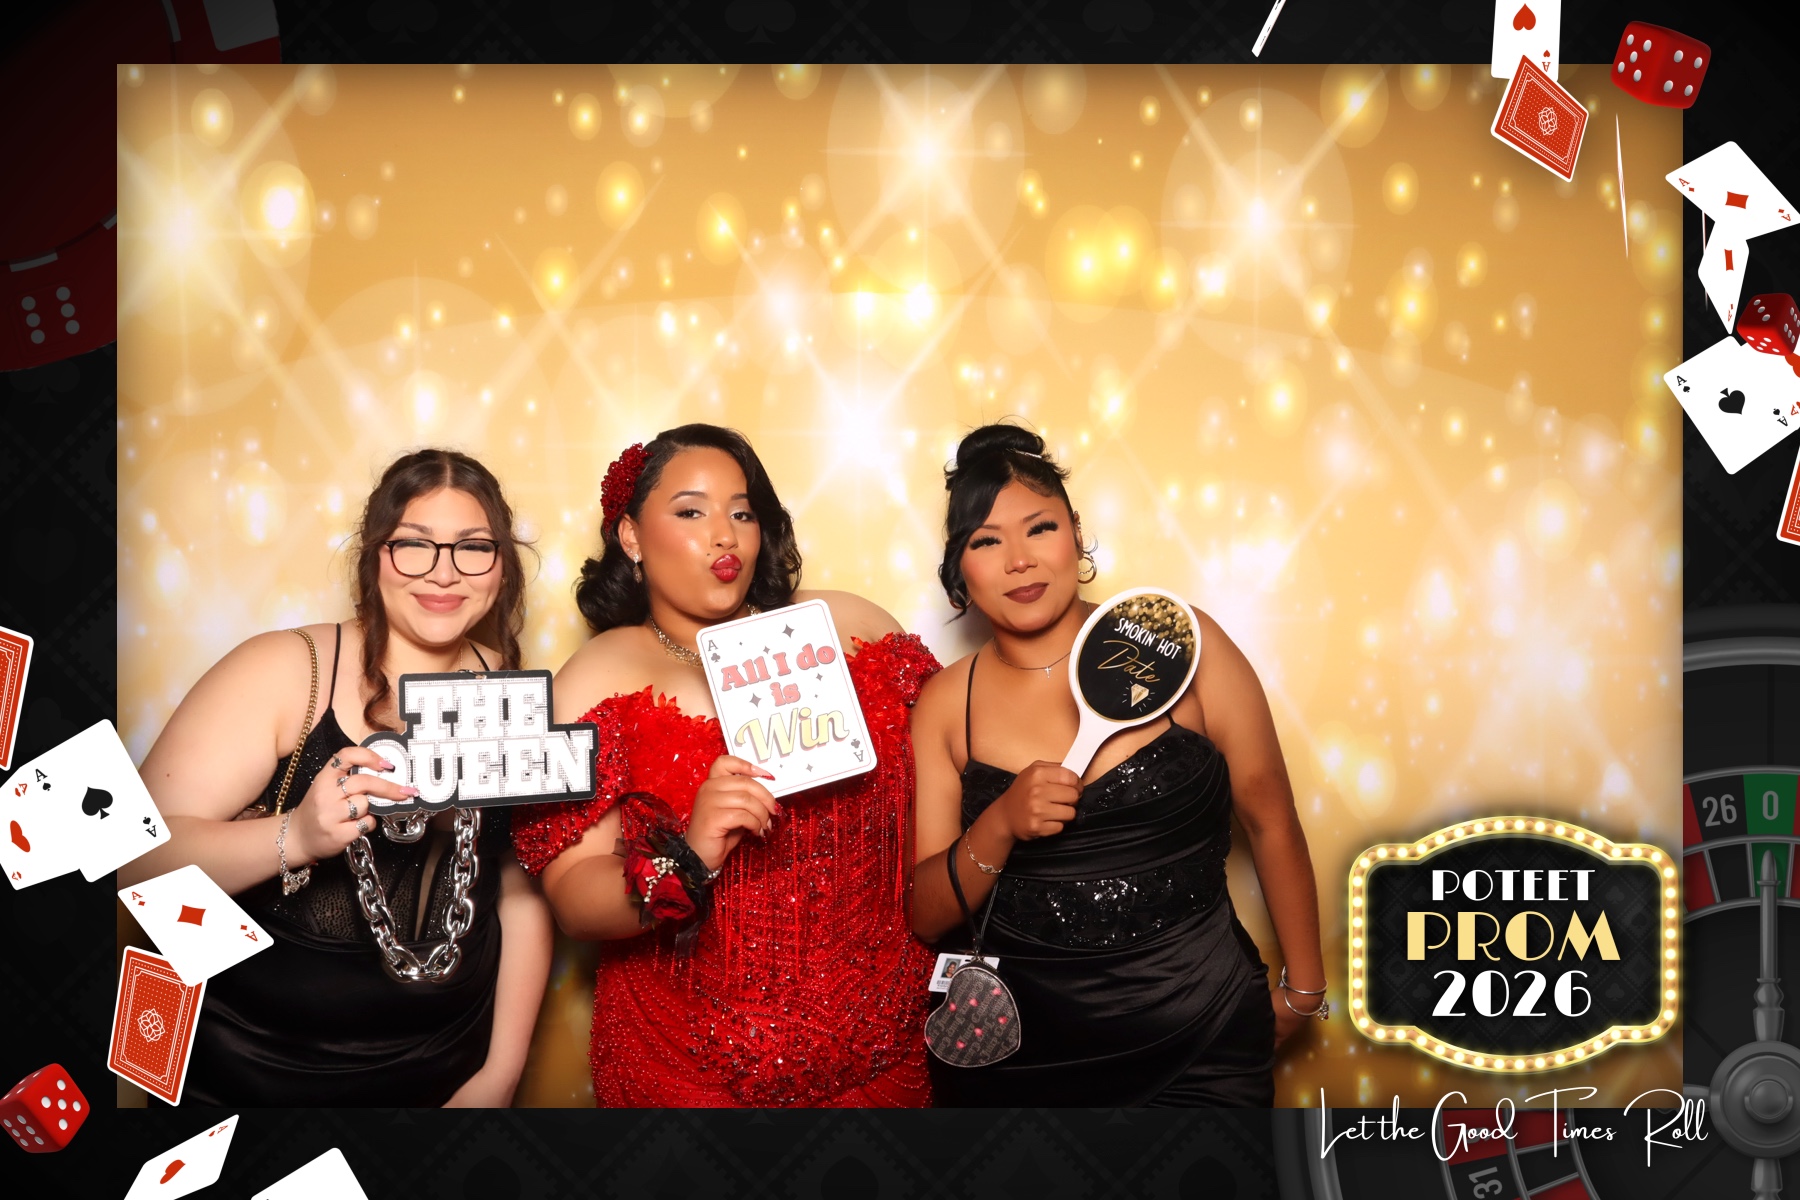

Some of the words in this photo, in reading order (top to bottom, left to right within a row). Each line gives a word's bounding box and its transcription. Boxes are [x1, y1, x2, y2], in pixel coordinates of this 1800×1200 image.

[707, 639, 719, 652] A
[1114, 617, 1159, 647] SMOKIN'
[1156, 639, 1182, 660] HOT
[720, 656, 771, 691] All
[772, 651, 791, 677] I
[796, 643, 836, 671] do
[1097, 639, 1160, 683] Date
[404, 676, 548, 740] THE
[769, 681, 801, 707] is
[734, 707, 850, 764] Win
[853, 749, 865, 763] A
[358, 729, 594, 807] QUEEN
